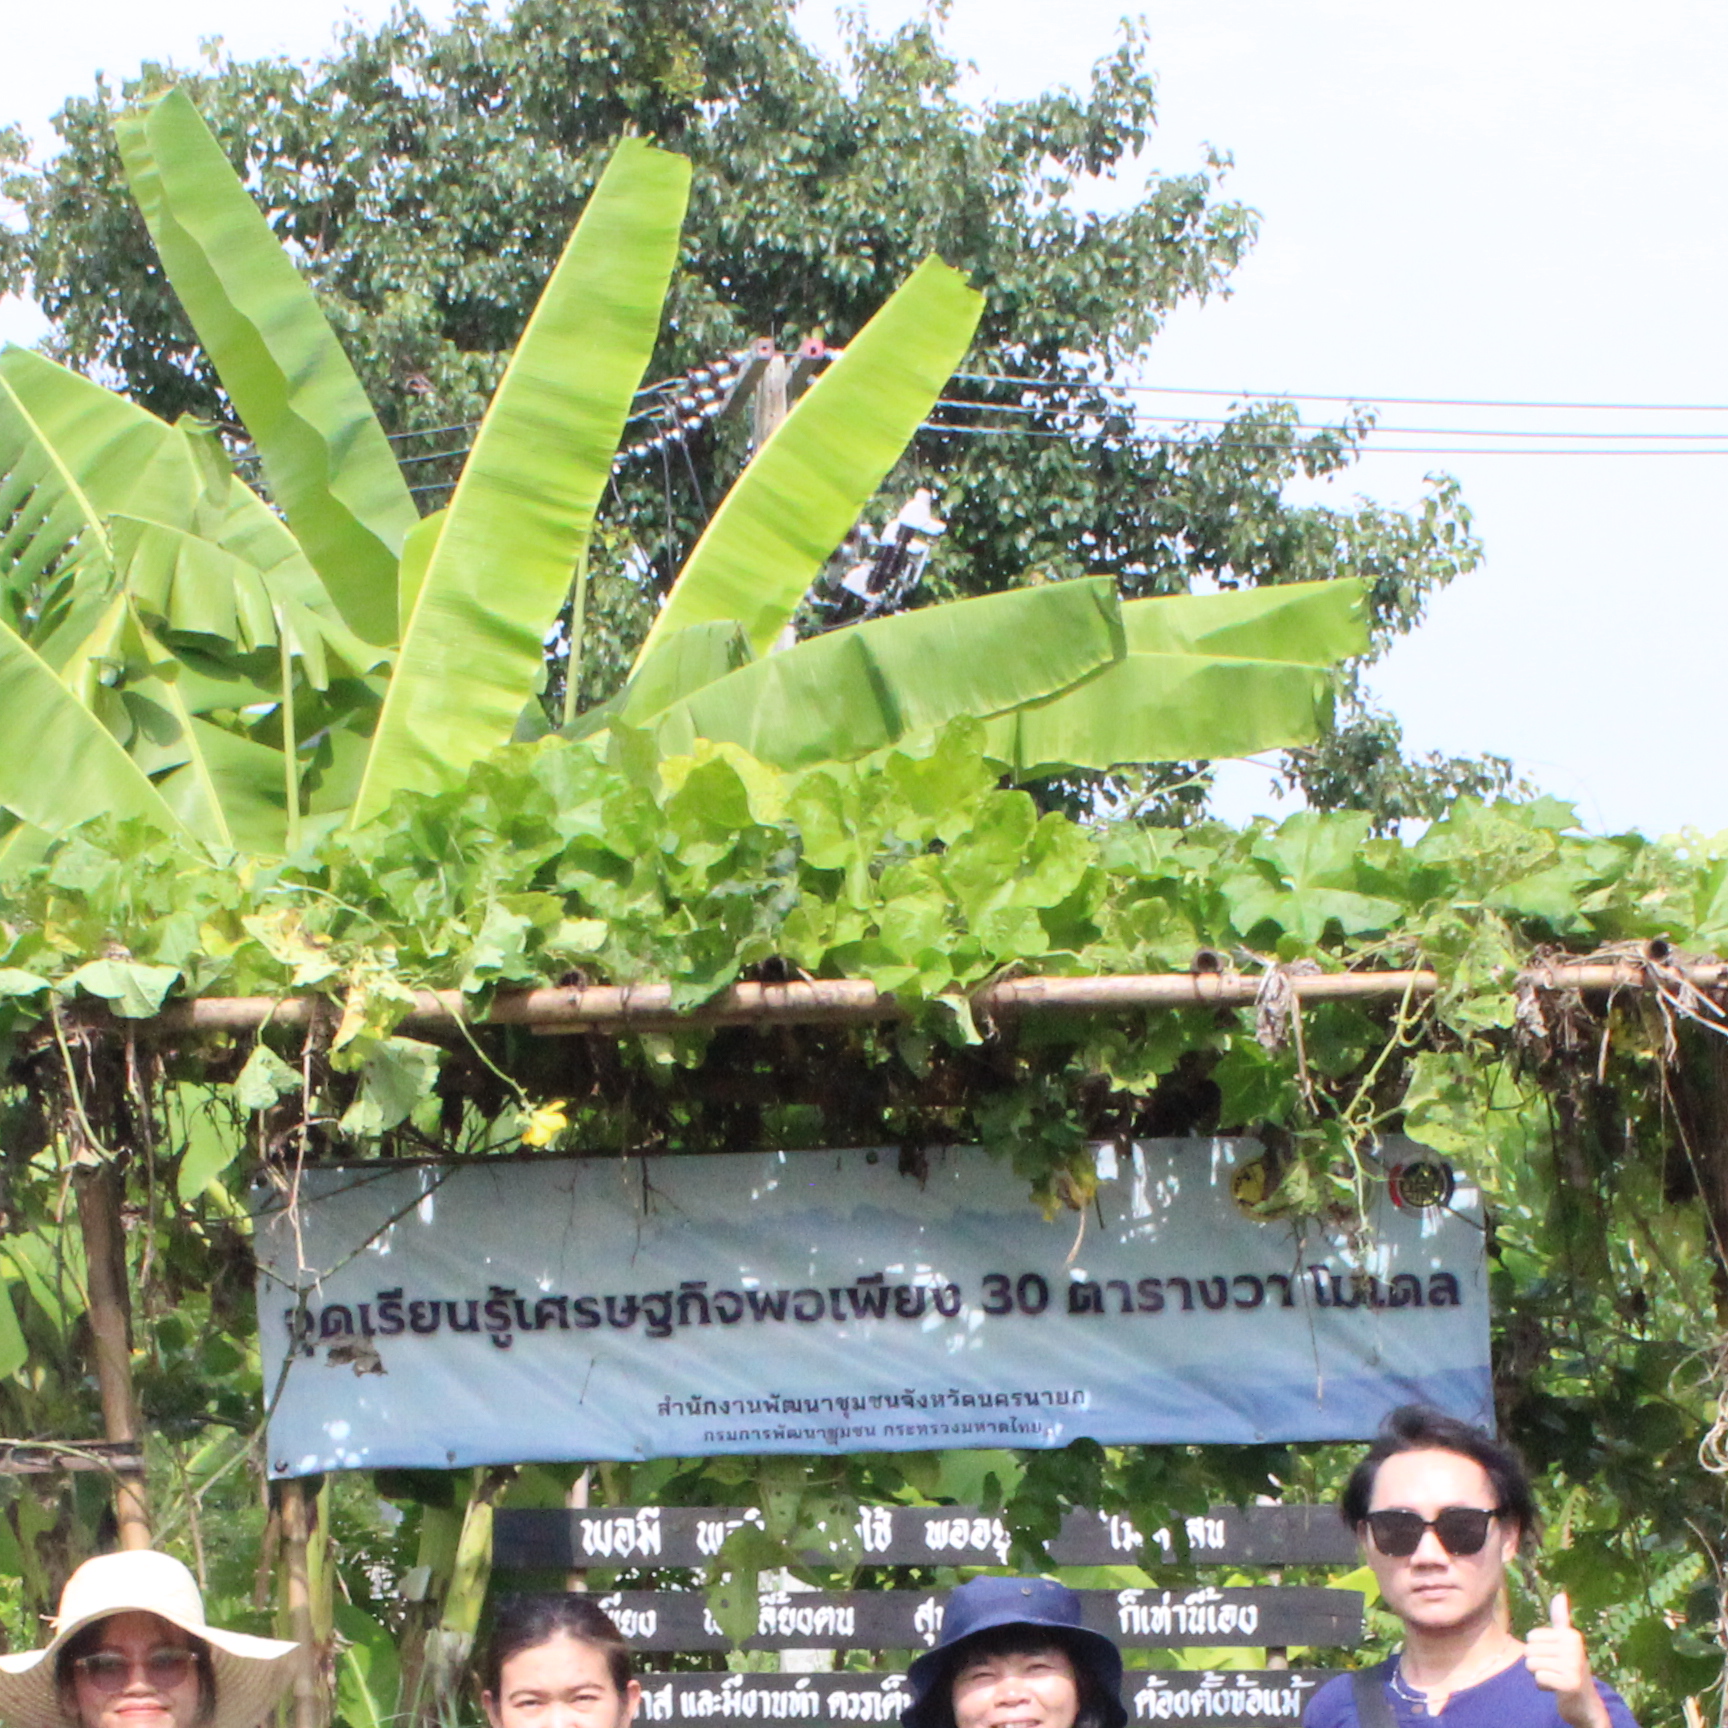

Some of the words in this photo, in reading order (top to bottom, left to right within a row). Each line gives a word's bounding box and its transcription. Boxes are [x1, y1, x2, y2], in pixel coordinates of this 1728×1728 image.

[982, 1273, 1050, 1315] 30
[1067, 1272, 1294, 1317] ตารางวา
[658, 1387, 1086, 1420] สำนักงานพัฒนาชุมชนจังหวัดนครนายก
[703, 1423, 877, 1446] กรมการพัฒนาชุมชน
[883, 1415, 1043, 1437] กระทรวงมหาดไทย
[579, 1506, 662, 1558] พอมี
[1117, 1586, 1259, 1635] ก็เท่านี้เอง
[680, 1673, 820, 1720] และมีงานทำ
[1133, 1671, 1317, 1719] ต้องตั้งข้อแม้
